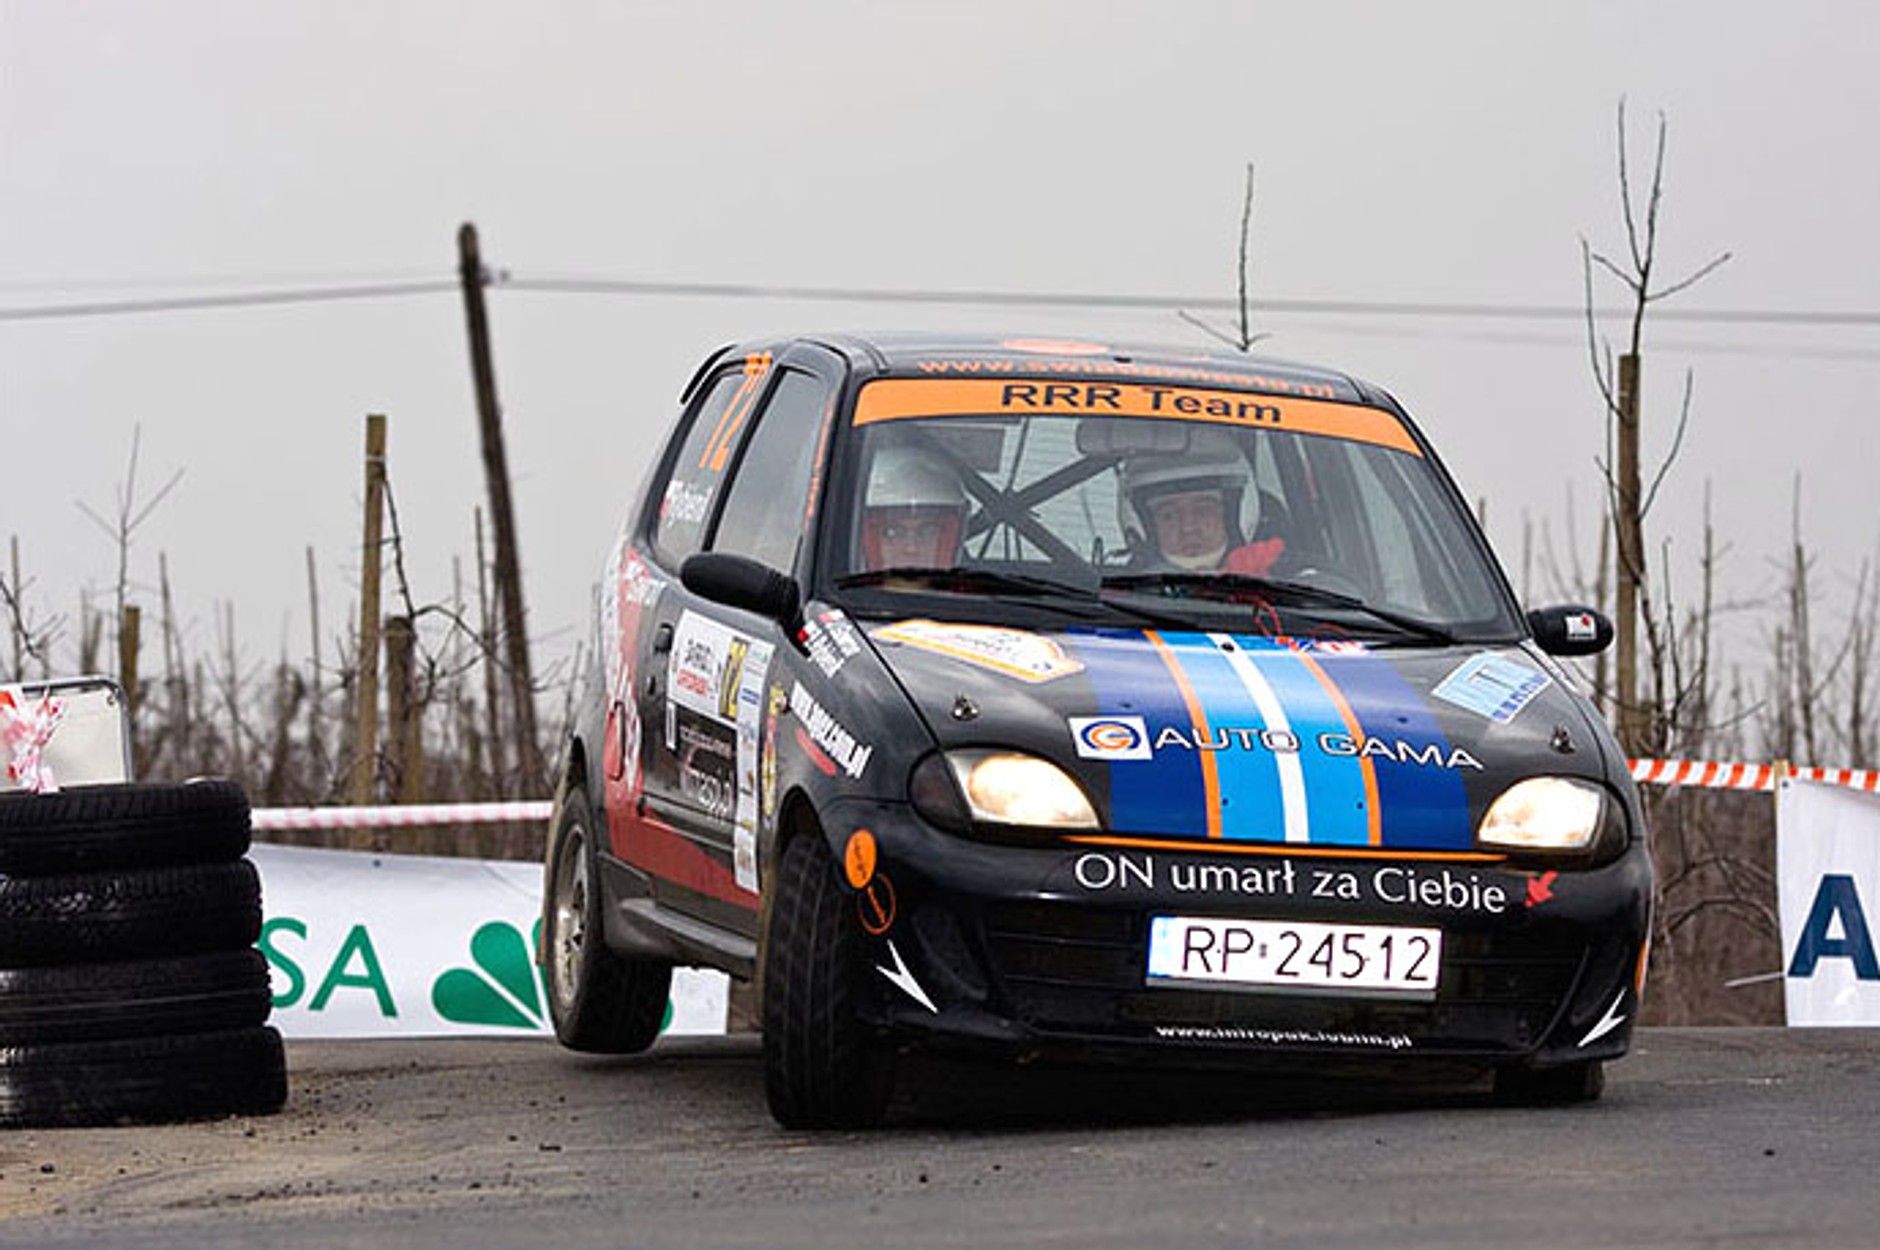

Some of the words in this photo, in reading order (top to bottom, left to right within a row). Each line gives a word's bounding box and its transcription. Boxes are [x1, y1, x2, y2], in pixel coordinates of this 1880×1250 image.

[1001, 384, 1122, 408] RRR
[1141, 387, 1282, 423] Team
[1154, 727, 1299, 755] AUTO
[1318, 732, 1485, 771] GAMA
[1074, 853, 1154, 889] ON
[1170, 859, 1297, 895] umarł
[1312, 871, 1361, 900] za
[1373, 868, 1507, 913] Ciebie
[1182, 926, 1255, 973] RP
[1275, 931, 1431, 981] 24512
